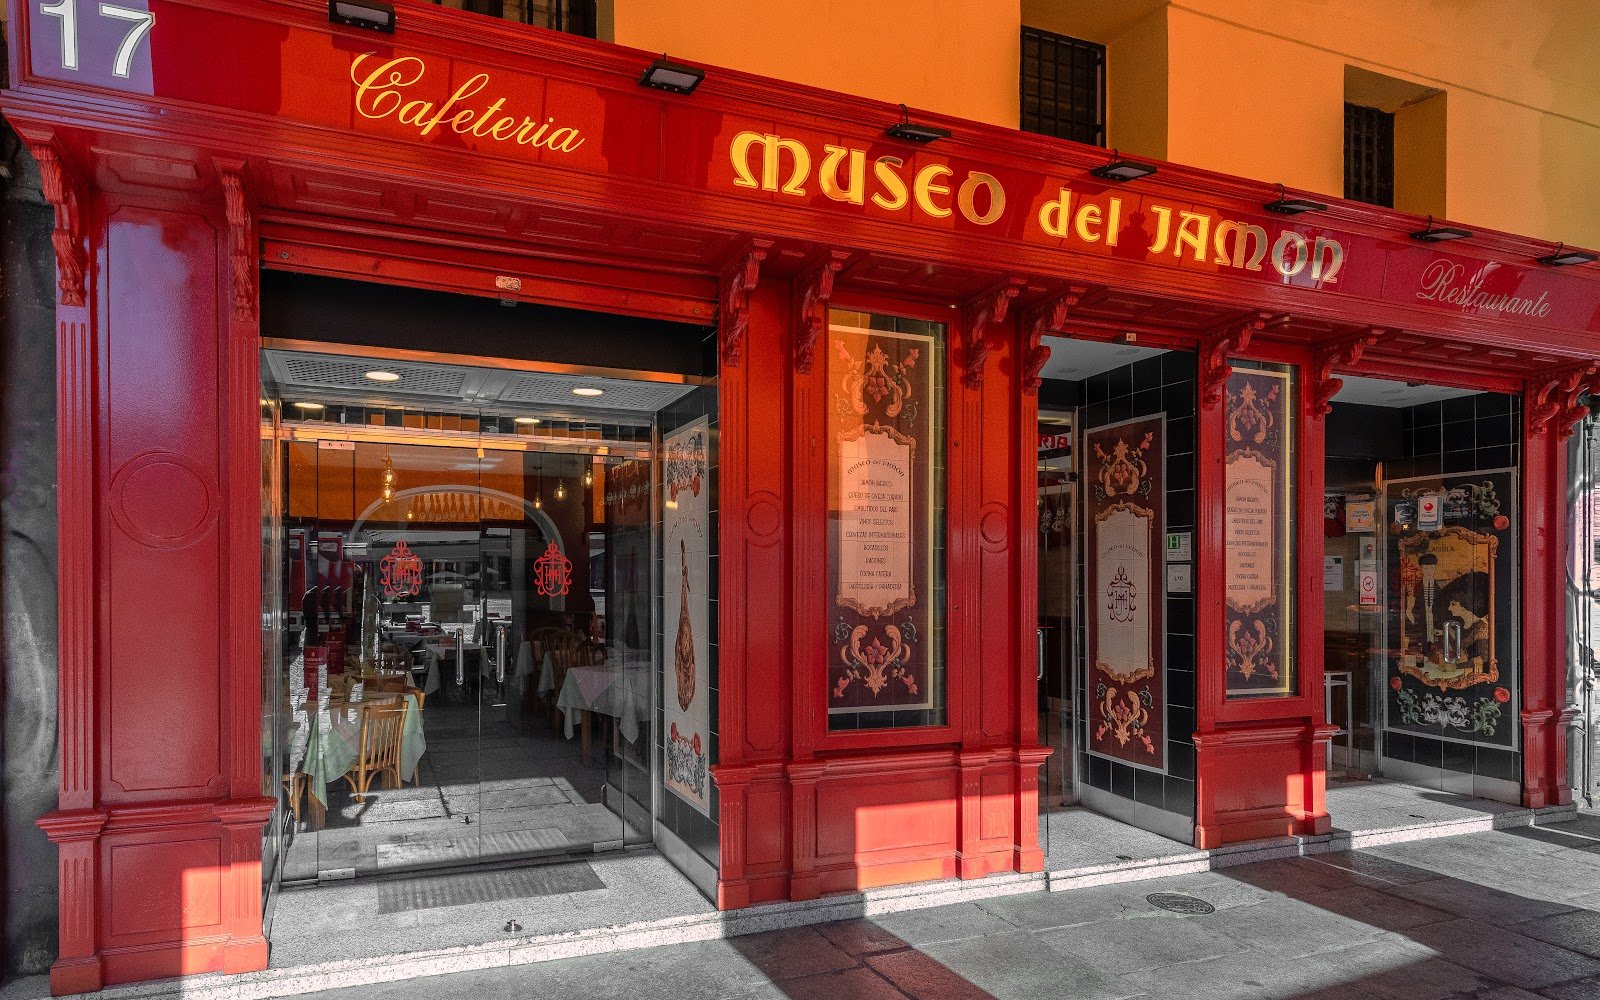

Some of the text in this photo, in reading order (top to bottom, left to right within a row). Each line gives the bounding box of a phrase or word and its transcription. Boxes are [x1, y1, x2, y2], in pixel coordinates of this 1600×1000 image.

[40, 0, 156, 79] 17
[350, 51, 585, 153] Cafeteria
[730, 130, 1346, 285] MUSEO del JAMON
[1416, 258, 1552, 318] Restaurante
